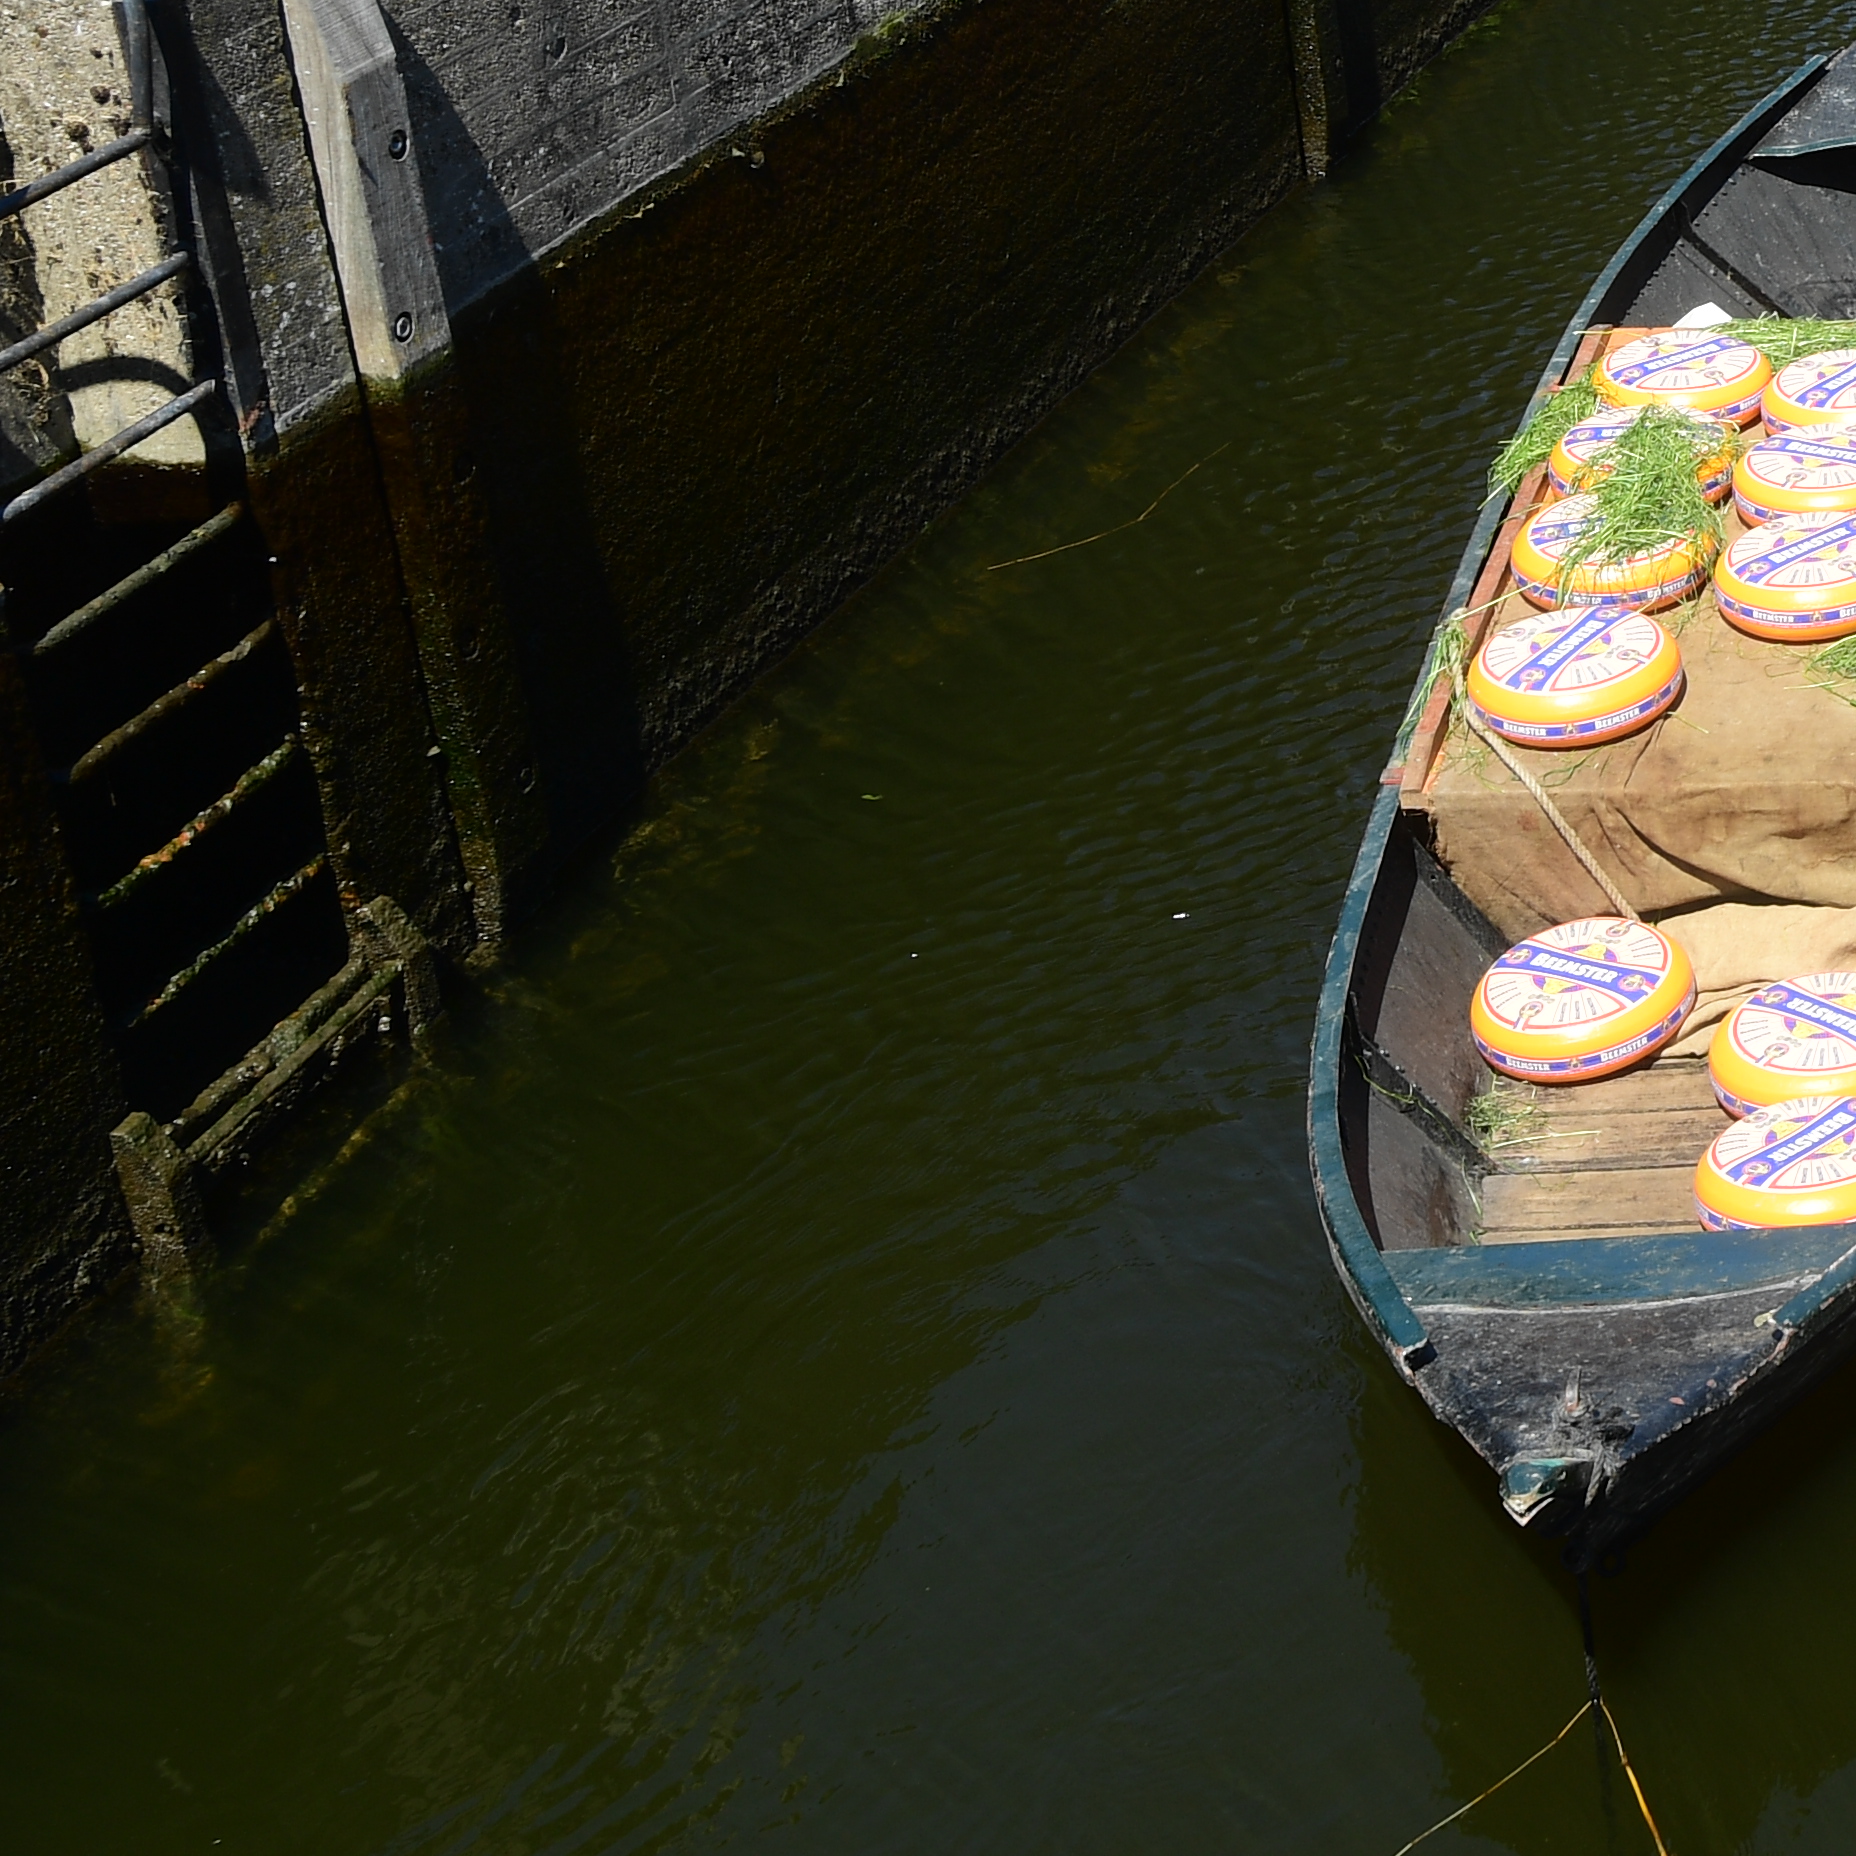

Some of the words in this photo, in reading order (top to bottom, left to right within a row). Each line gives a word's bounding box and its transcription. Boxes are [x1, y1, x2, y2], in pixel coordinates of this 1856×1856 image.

[1643, 343, 1721, 371] BEEMSTER
[1767, 526, 1853, 564] BEEMSTER
[1752, 609, 1795, 623] BEEMSTER
[1538, 619, 1606, 668] BEEMSTER
[1503, 721, 1547, 737] BEEMSTER
[1594, 706, 1641, 730] BEEMSTER
[1529, 952, 1620, 984] BEEMSTER
[1599, 1036, 1648, 1063] BEEMSTER
[1505, 1056, 1551, 1072] BEEMSTER
[1766, 1111, 1856, 1163] BEEMSTER
